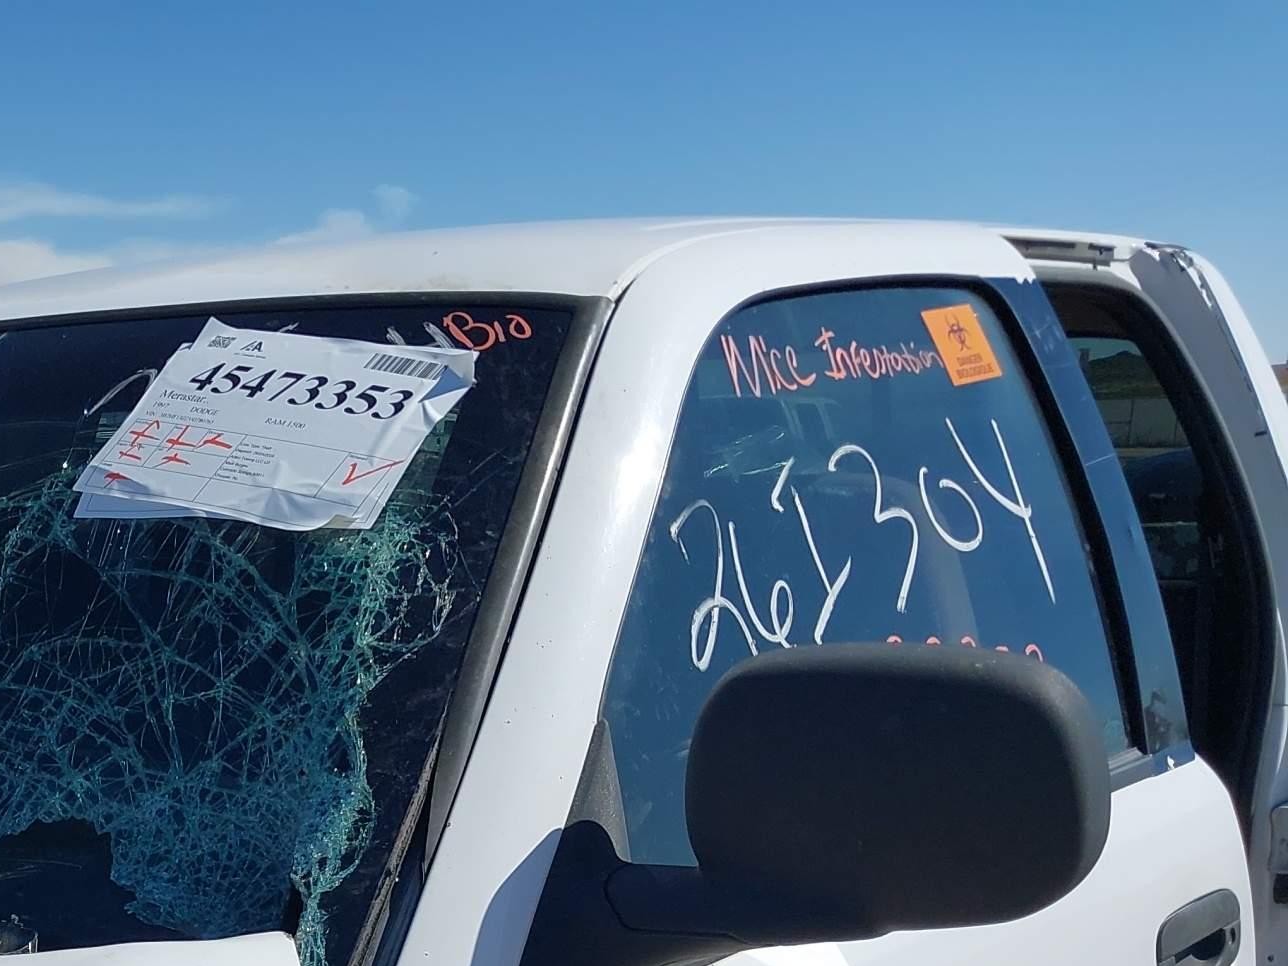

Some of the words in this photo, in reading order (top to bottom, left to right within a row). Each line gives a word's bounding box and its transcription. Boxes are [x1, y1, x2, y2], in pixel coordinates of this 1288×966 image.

[188, 362, 414, 420] 45473353
[720, 334, 816, 398] Mice
[190, 406, 219, 417] DODGE
